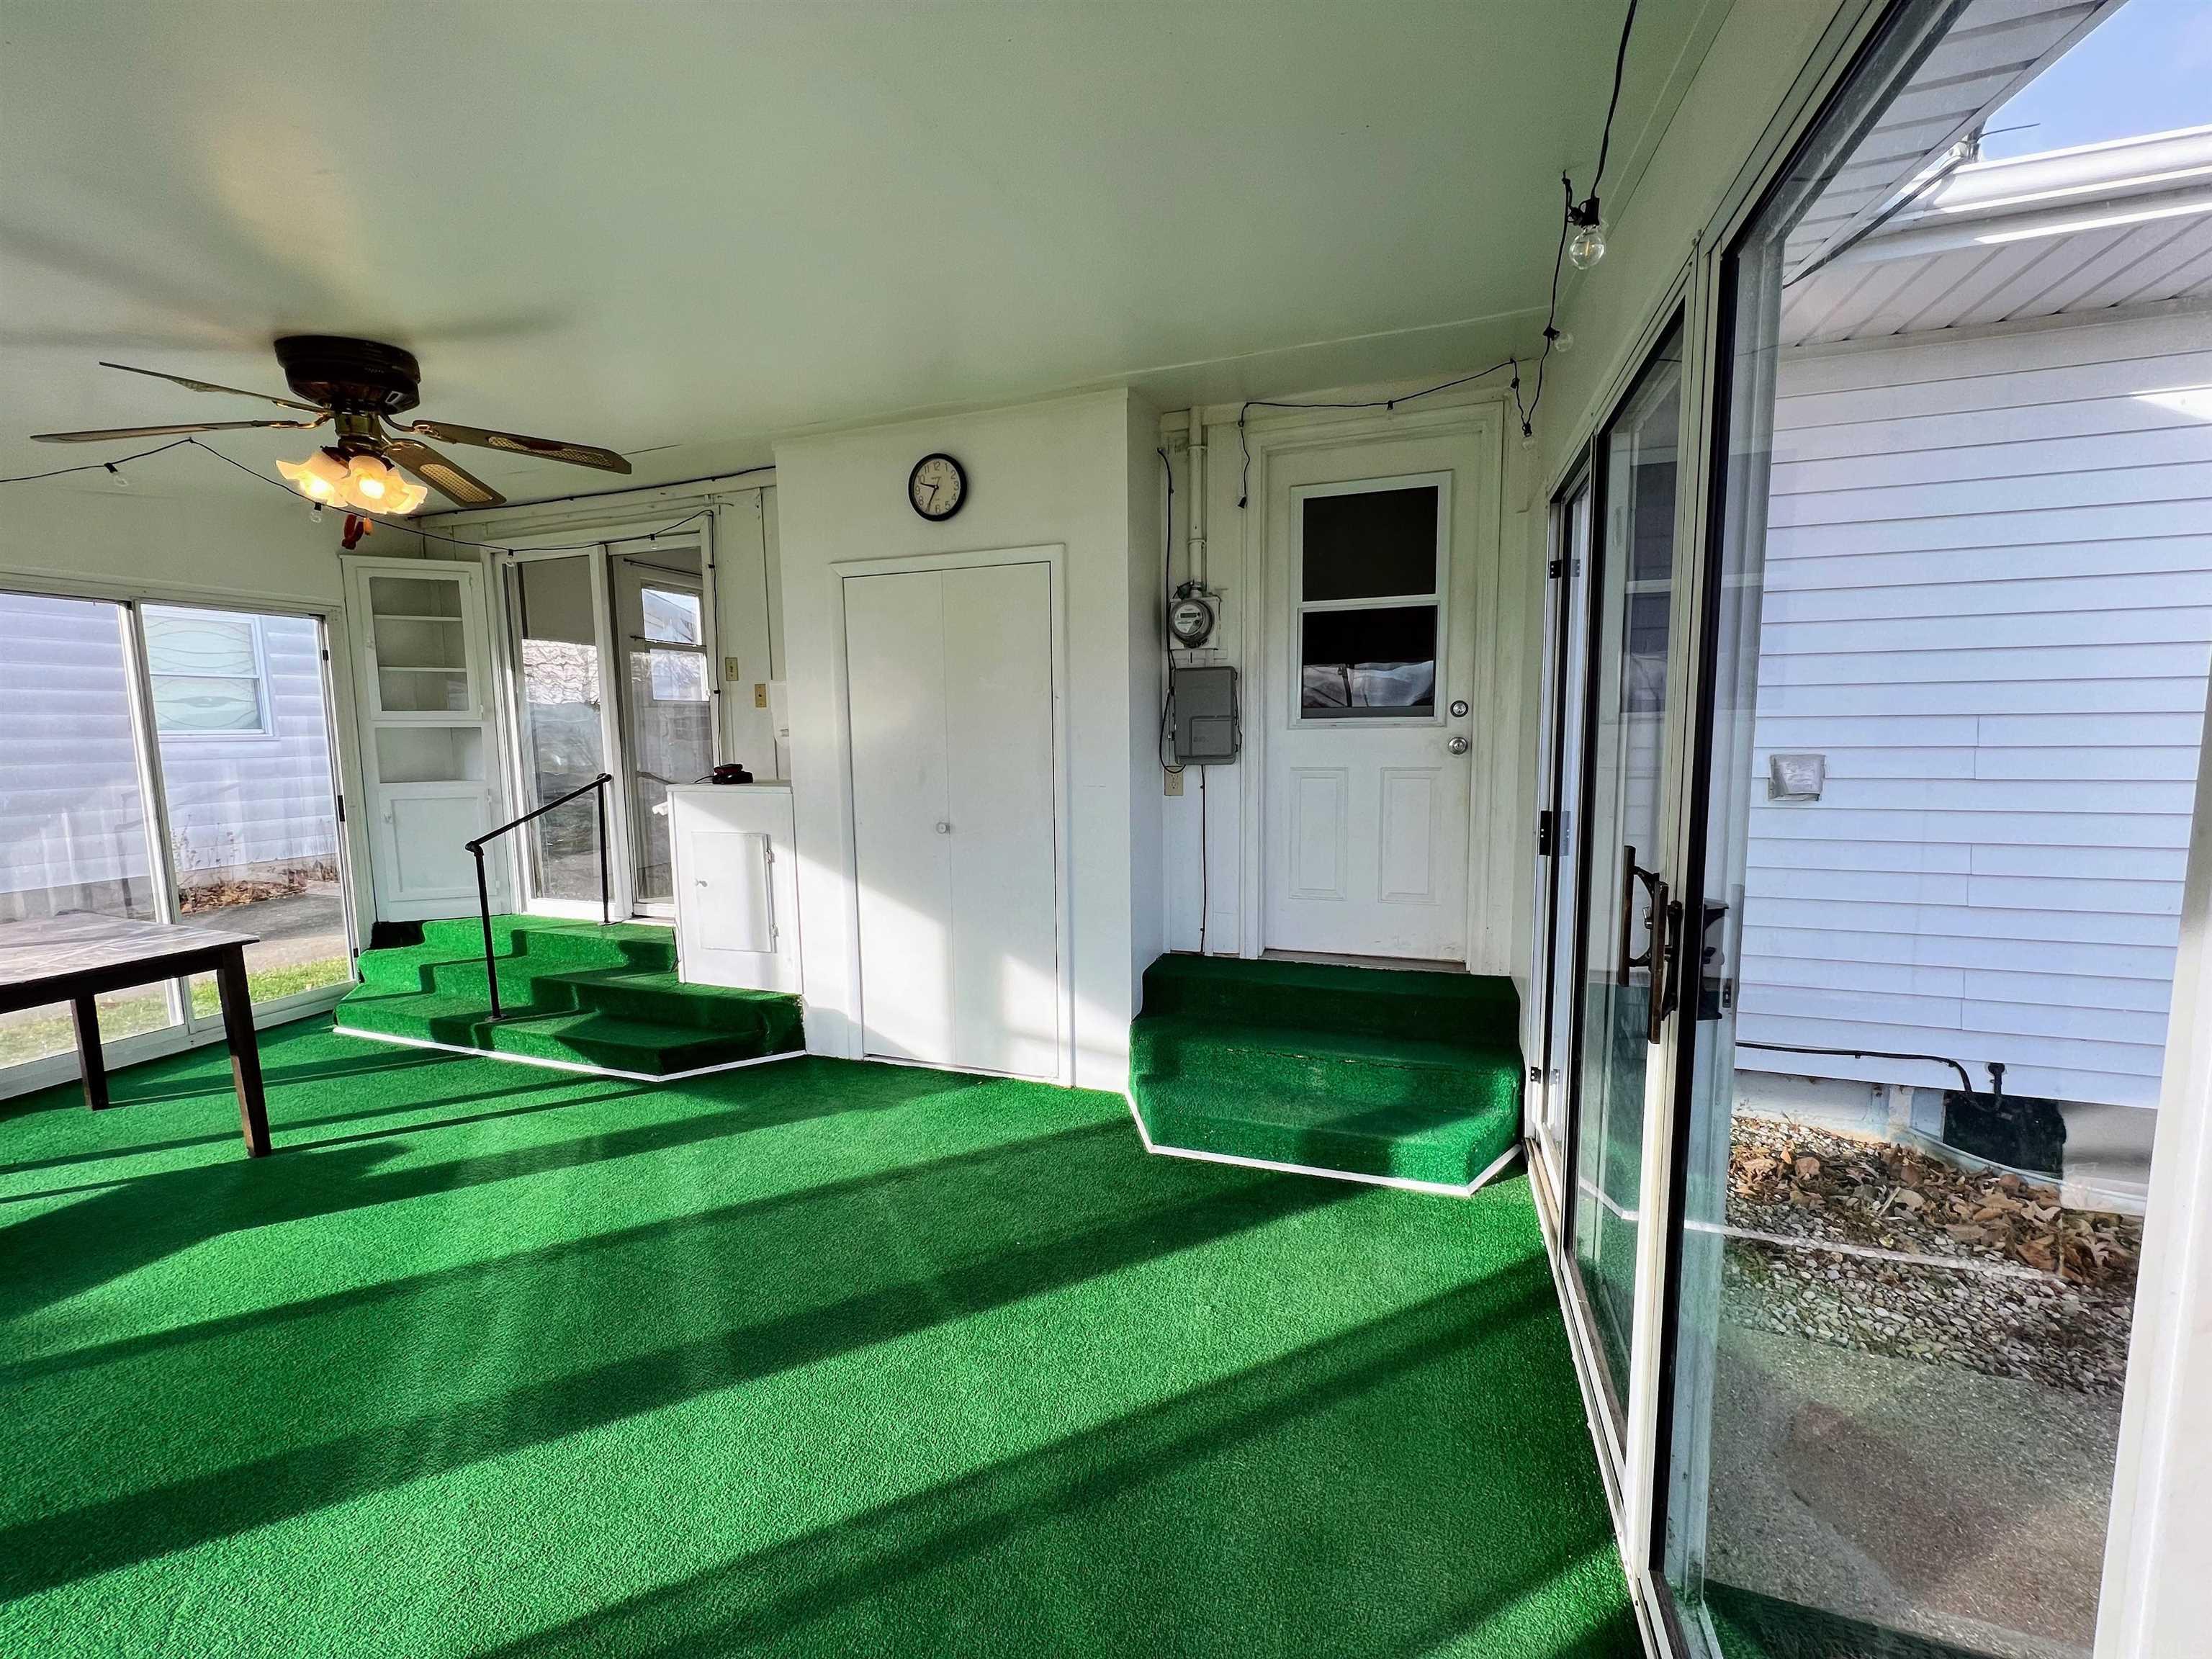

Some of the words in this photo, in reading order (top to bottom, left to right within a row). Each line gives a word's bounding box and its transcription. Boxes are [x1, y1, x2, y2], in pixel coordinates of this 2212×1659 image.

[924, 464, 930, 474] 11
[933, 461, 940, 471] 12
[950, 469, 956, 480] 2
[915, 485, 920, 495] 9
[953, 480, 959, 490] 3
[951, 493, 956, 502] 4
[945, 500, 950, 511] 5
